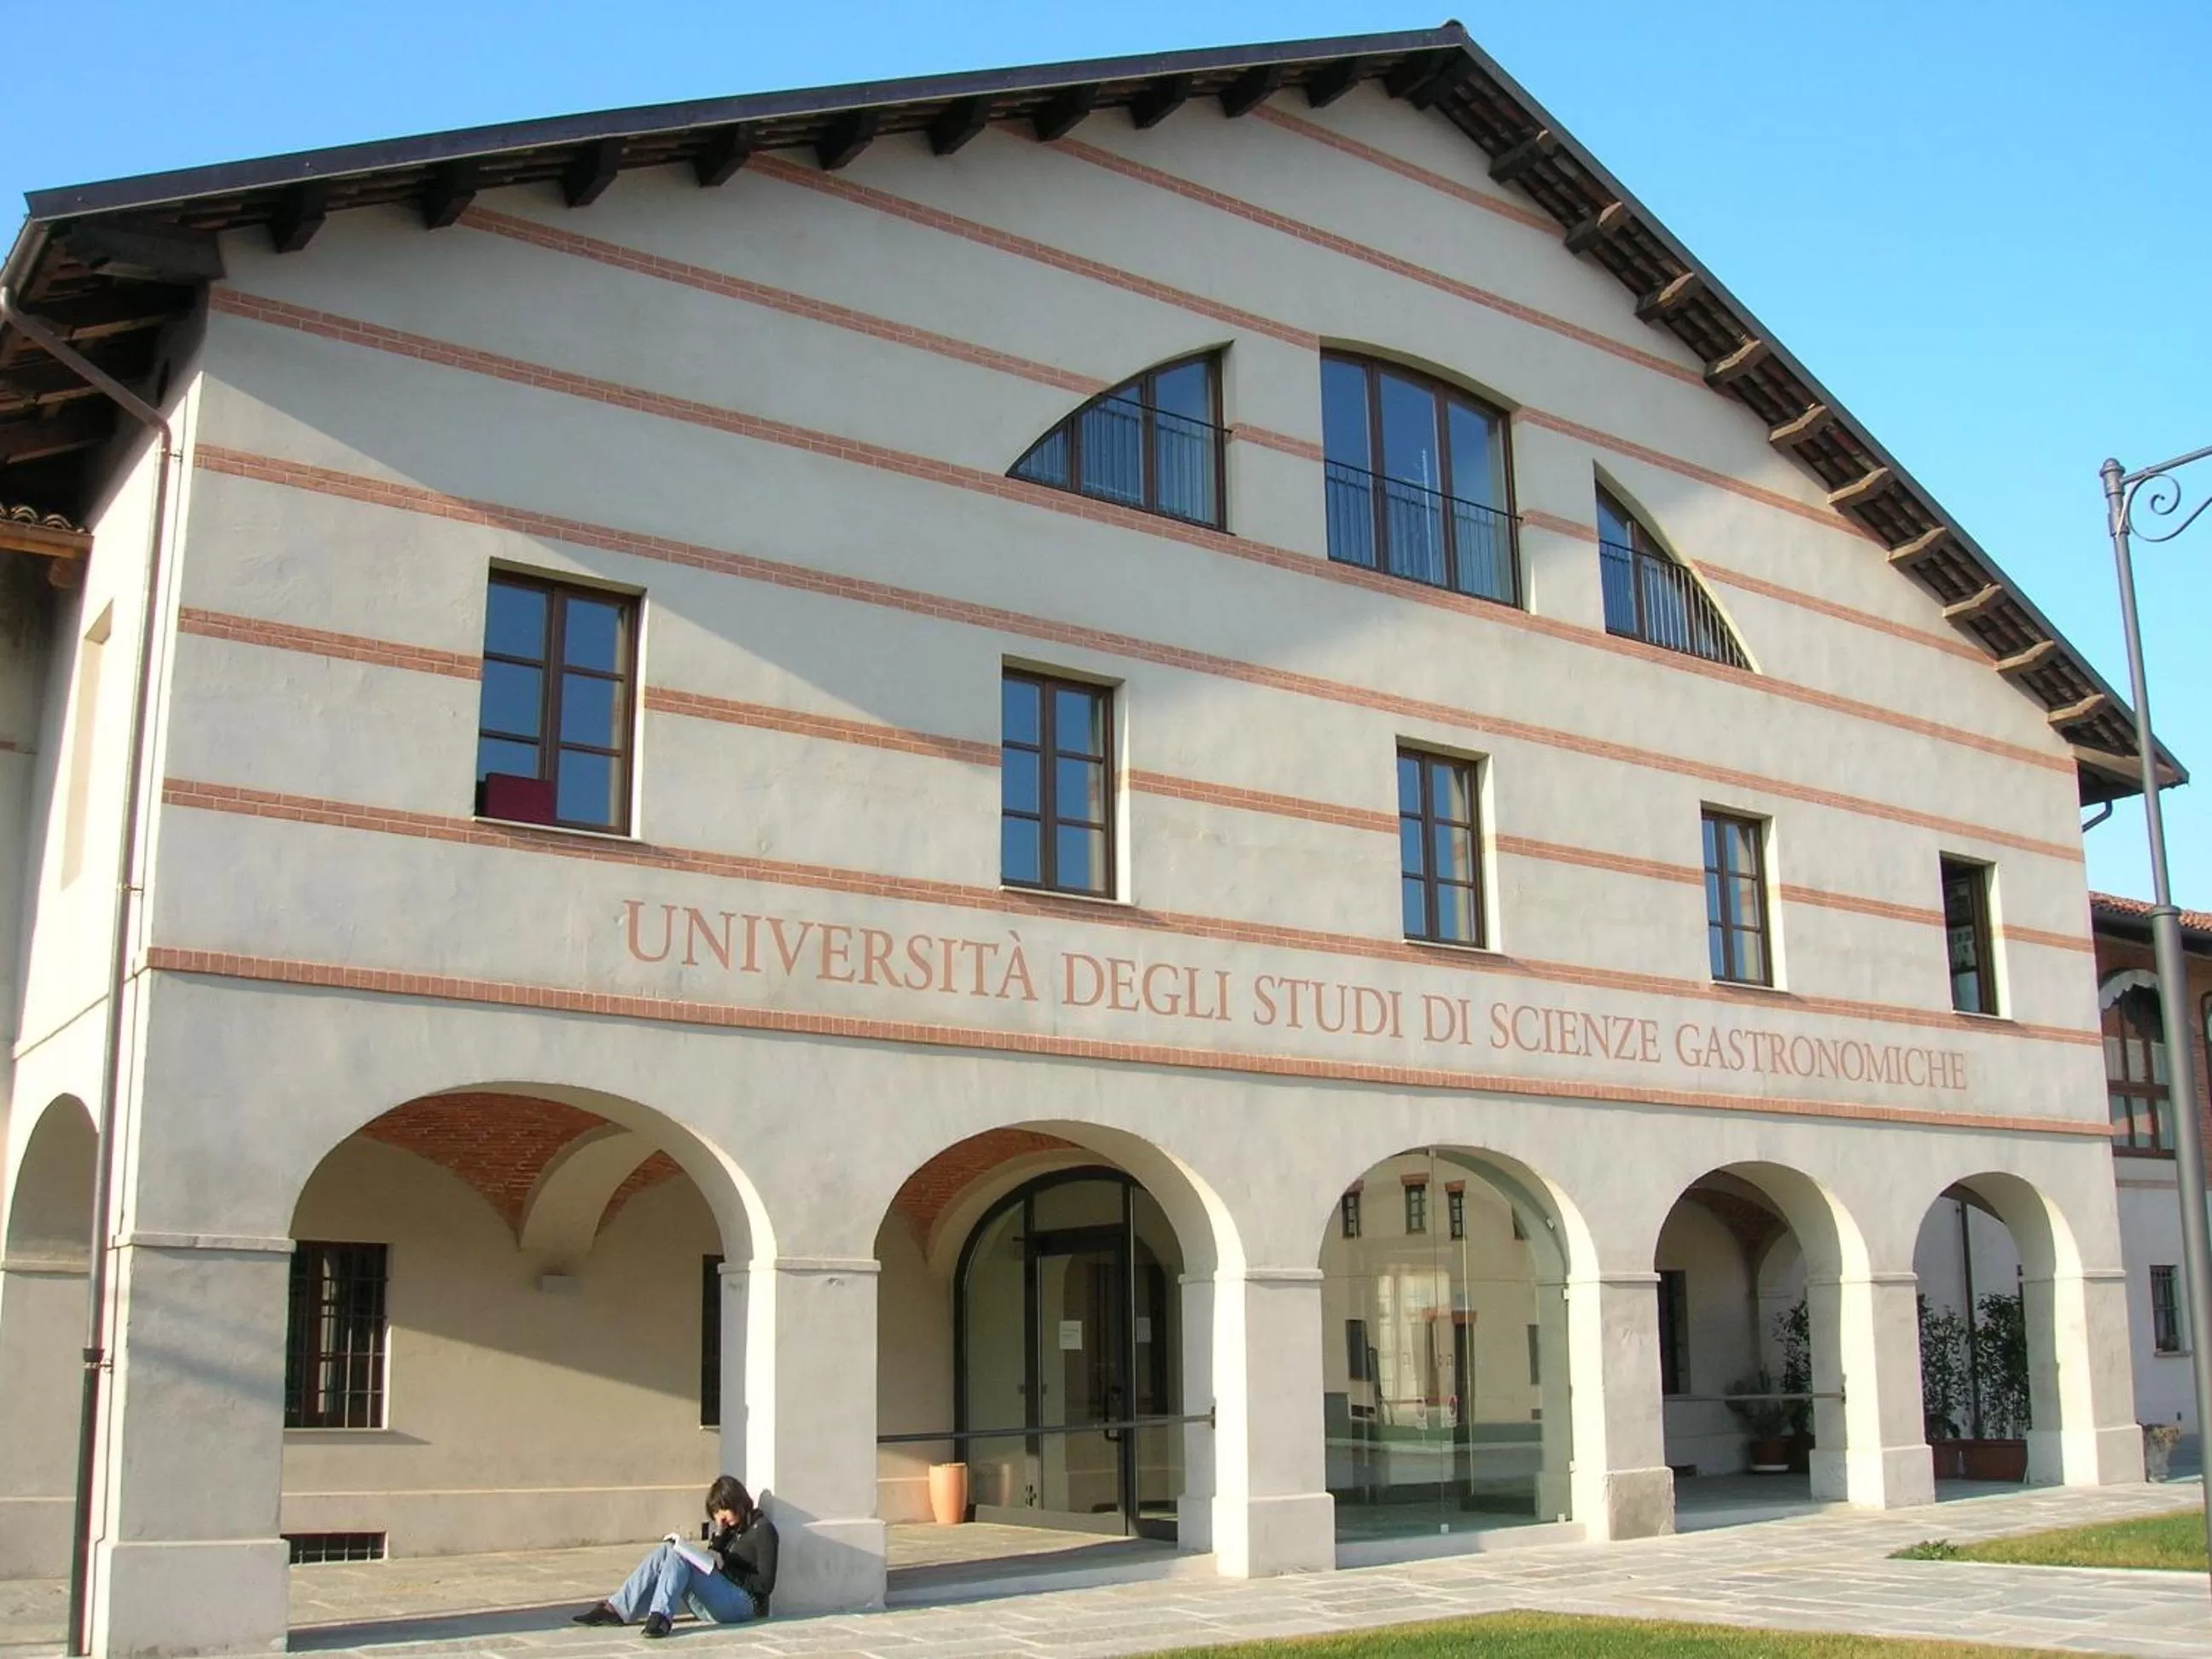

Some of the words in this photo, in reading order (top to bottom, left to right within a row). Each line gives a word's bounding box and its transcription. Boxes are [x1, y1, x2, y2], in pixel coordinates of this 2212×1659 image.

[622, 899, 1039, 1001] UNIVERSITÀ
[1061, 952, 1233, 1022] DEGLI
[1253, 975, 1404, 1039] STUDI
[1423, 994, 1472, 1045] DI
[1489, 1002, 1662, 1062] SCIENZE
[1674, 1023, 1967, 1091] GASTRONOMICHE
